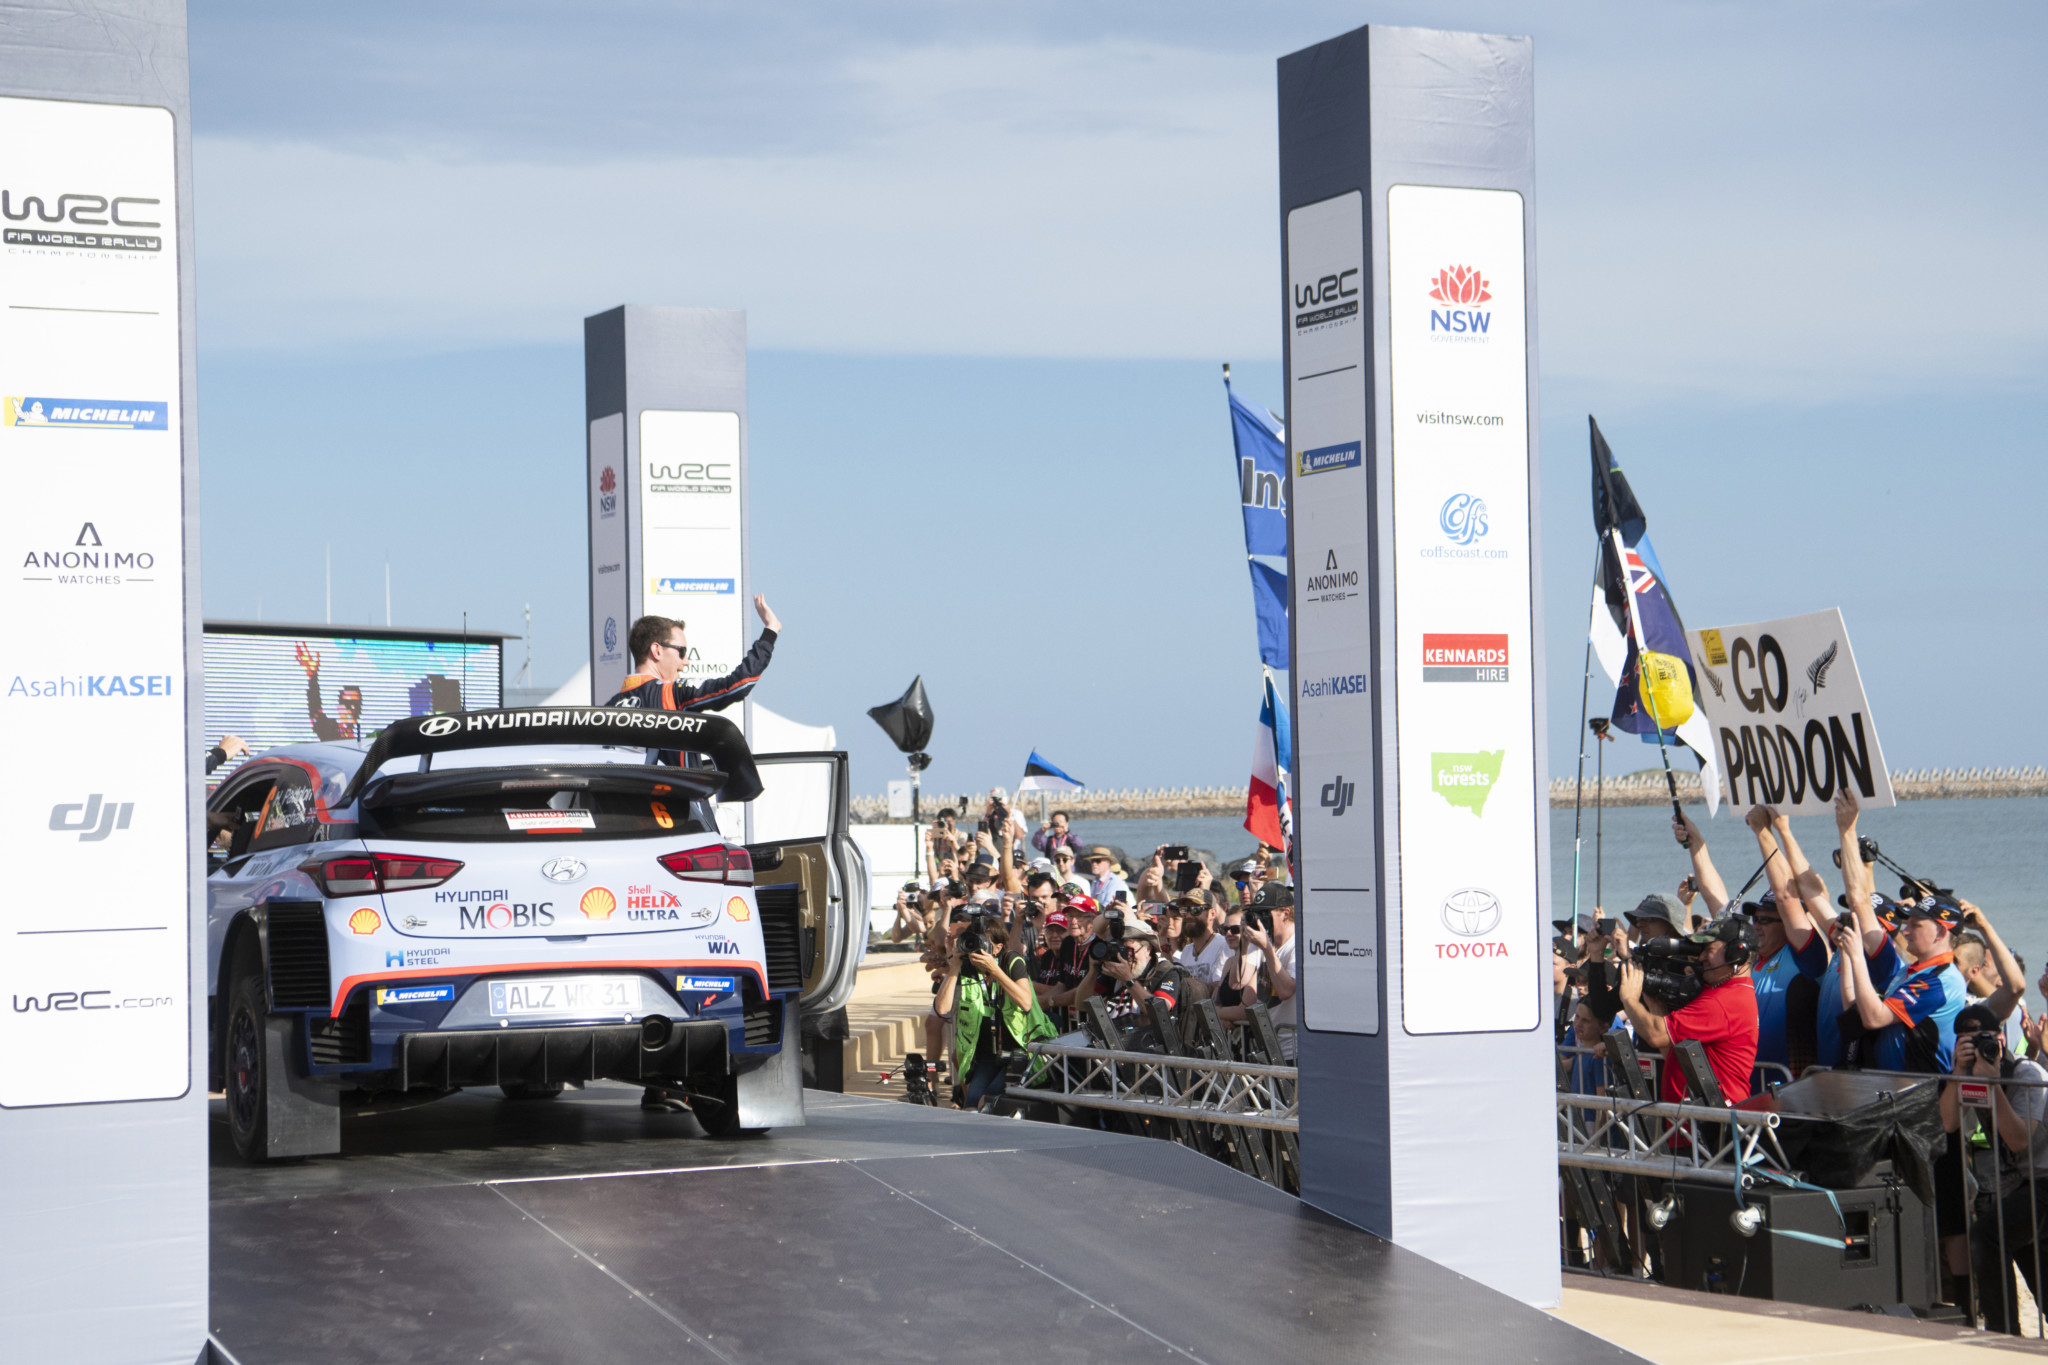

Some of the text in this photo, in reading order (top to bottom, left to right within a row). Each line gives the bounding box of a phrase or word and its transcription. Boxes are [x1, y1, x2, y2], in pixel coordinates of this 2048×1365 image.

[2, 190, 161, 228] WRC
[7, 231, 158, 249] FIA WORLD RALLY
[1295, 267, 1358, 309] WRC
[1430, 309, 1491, 333] NSW
[1430, 334, 1490, 345] GOVERNMENT
[50, 407, 155, 423] MICHELIN
[1416, 411, 1504, 427] visitnsw.com
[1313, 450, 1356, 468] MICHELIN
[650, 462, 731, 480] WRC
[600, 495, 617, 513] NSW
[23, 551, 154, 569] ANONIMO
[1420, 546, 1509, 559] coffscoast.com
[58, 575, 121, 585] WATCHES
[674, 582, 729, 591] MICHELIN
[1307, 570, 1359, 592] ANONIMO
[1320, 592, 1346, 603] WATCHES
[1425, 648, 1506, 663] KENNARDS
[1476, 668, 1506, 681] HIRE
[1731, 634, 1789, 714] GO
[467, 711, 707, 733] HYUNDAI MOTORSPORT
[1719, 712, 1876, 806] PADDON
[1452, 764, 1473, 772] nsw
[1438, 769, 1490, 786] forests
[509, 810, 587, 819] KENNARDS HIRE
[651, 801, 674, 829] 6
[435, 889, 509, 903] HYUNDAI
[628, 885, 651, 895] Shell
[627, 895, 681, 909] HELIX
[459, 902, 556, 930] MOBIS
[627, 910, 680, 921] ULTRA
[406, 948, 451, 957] HYUNDAI
[708, 940, 740, 954] WIA
[1435, 942, 1509, 959] TOYOTA
[406, 957, 439, 966] STEEL
[693, 980, 731, 988] MICHELIN
[398, 989, 449, 1000] MICHELIN
[509, 985, 556, 1010] ALZ
[602, 983, 630, 1006] 31
